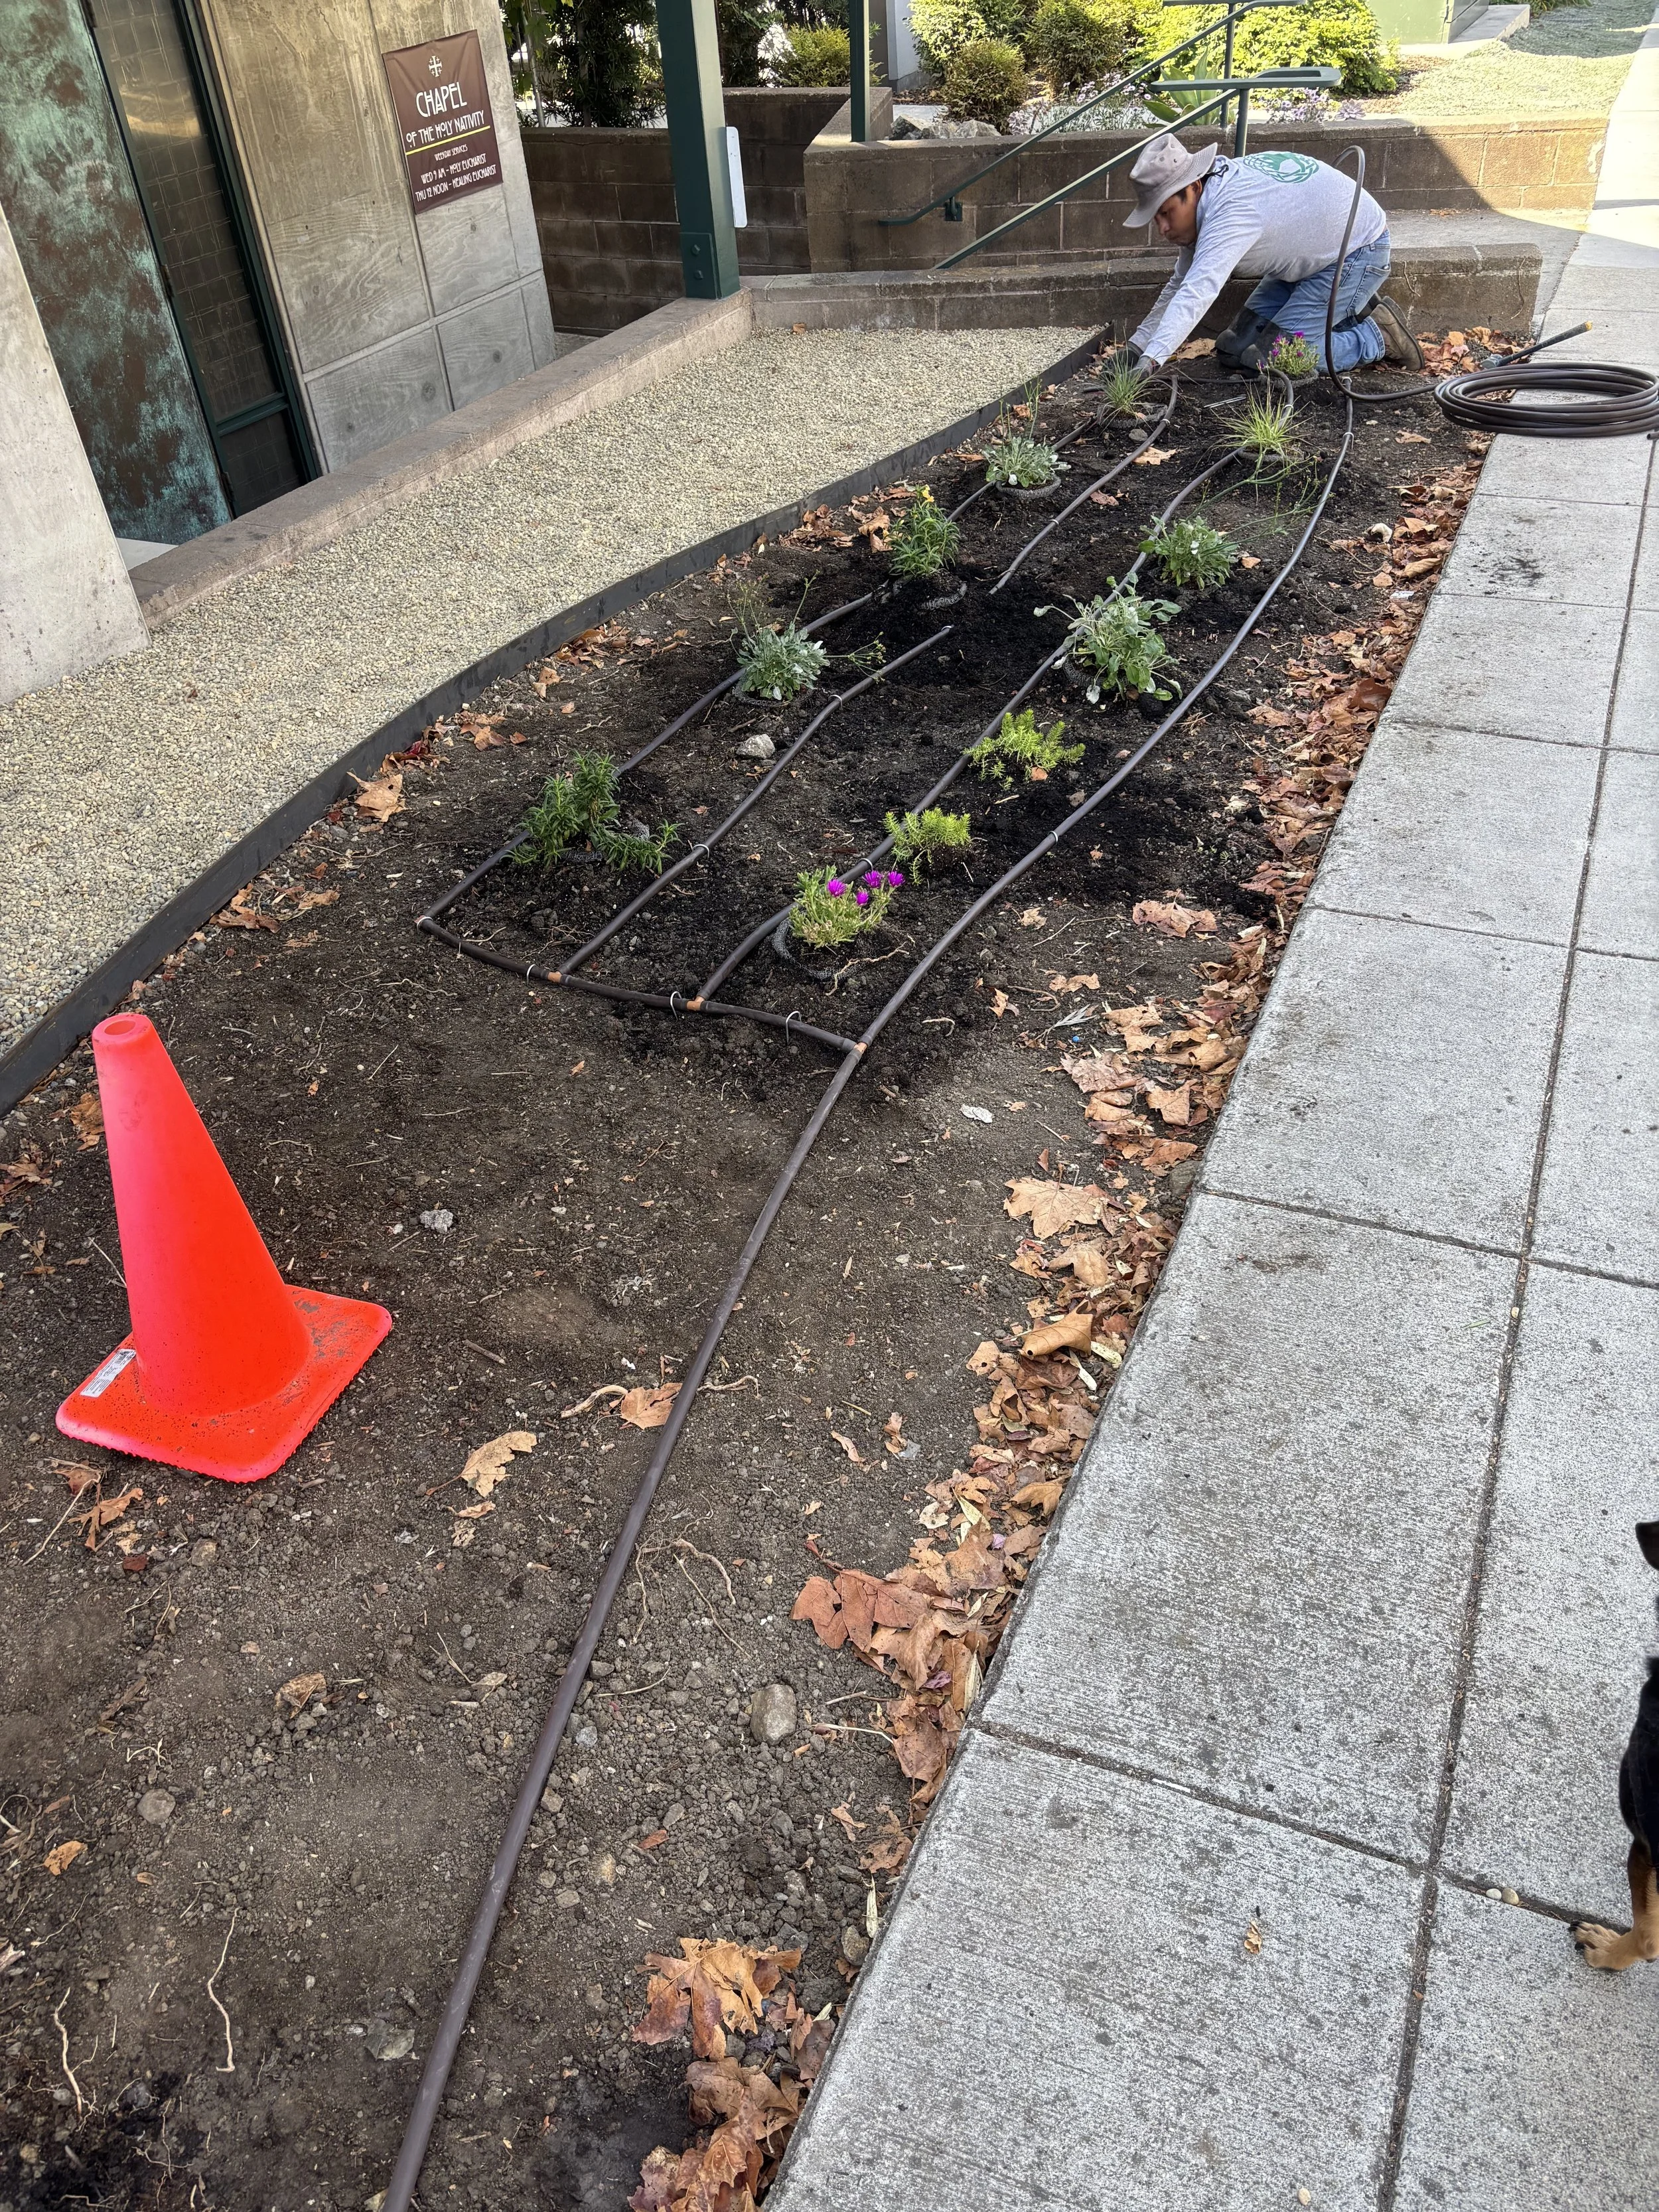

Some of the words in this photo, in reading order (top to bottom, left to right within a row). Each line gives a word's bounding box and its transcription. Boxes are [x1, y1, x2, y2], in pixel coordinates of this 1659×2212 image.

[416, 82, 467, 117] CHAPEL
[406, 132, 417, 147] OF
[418, 126, 435, 144] THE
[435, 120, 453, 139] HOLY
[455, 110, 484, 133] NATIVITY
[421, 172, 433, 184] WED
[433, 171, 437, 180] 9
[438, 168, 446, 179] AM
[450, 162, 461, 175] HOLY
[462, 153, 486, 170] EUCHARIST
[434, 151, 452, 161] WEEKDAY
[452, 145, 468, 156] SERVICES
[415, 190, 426, 202] THU
[426, 187, 433, 197] 12
[433, 182, 449, 196] NOON
[453, 173, 472, 188] HEALING
[472, 165, 496, 181] EUCHARIST
